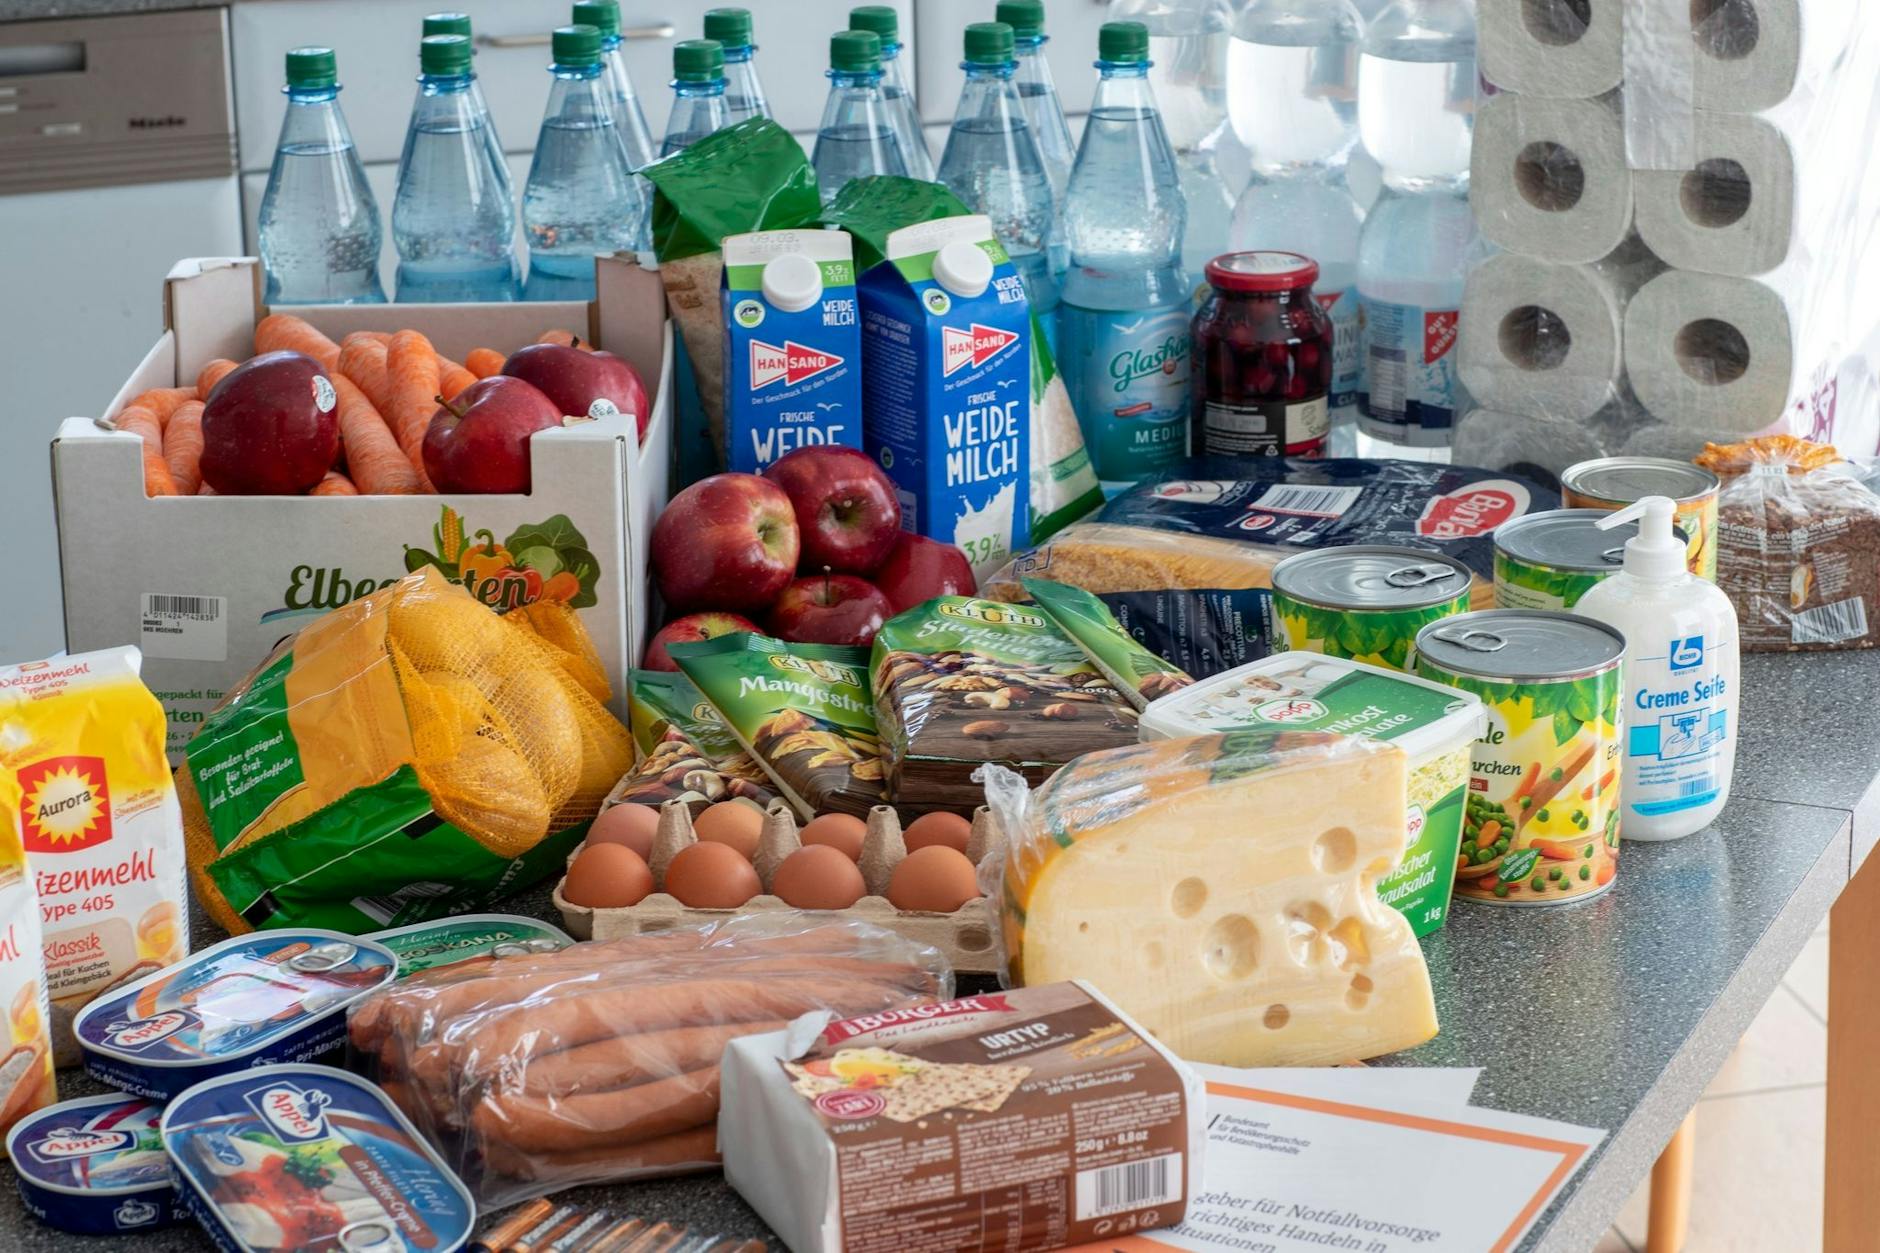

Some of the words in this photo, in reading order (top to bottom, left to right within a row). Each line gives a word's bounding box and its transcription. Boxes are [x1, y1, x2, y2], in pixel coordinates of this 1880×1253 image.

[991, 275, 1022, 292] WEIDE
[822, 299, 855, 313] WEIDE
[997, 287, 1026, 305] MILCH
[822, 311, 855, 327] MILCH
[967, 390, 997, 406] FRISCHE
[780, 411, 816, 423] FRISCHE
[943, 400, 1020, 449] WEIDE
[946, 437, 1018, 488] MILCH
[947, 604, 1040, 626] KLUTH
[916, 618, 1067, 650] Studenten
[780, 655, 857, 685] KLUTH
[48, 679, 69, 687] 405
[1635, 688, 1689, 710] Creme
[1694, 674, 1727, 702] Seife
[206, 689, 224, 700] für
[1268, 699, 1313, 722] popp
[1475, 721, 1505, 745] le
[37, 789, 92, 821] Aurora
[81, 894, 115, 913] 405
[60, 969, 113, 989] Kleingebäck
[62, 967, 76, 979] für
[77, 960, 110, 974] Kuchen
[855, 998, 989, 1033] BURGER
[121, 1013, 181, 1045] Appel
[979, 1022, 1051, 1051] URTYP
[270, 1092, 318, 1136] Appel
[1222, 1114, 1271, 1130] Bundesamt
[47, 1135, 122, 1153] Appel
[353, 1159, 370, 1179] in
[1192, 1191, 1252, 1211] geber
[1252, 1197, 1286, 1218] für
[1285, 1203, 1442, 1244] Notfallvorsorge
[1190, 1211, 1276, 1238] richtiges
[1276, 1223, 1364, 1253] Handeln
[1365, 1240, 1388, 1253] in
